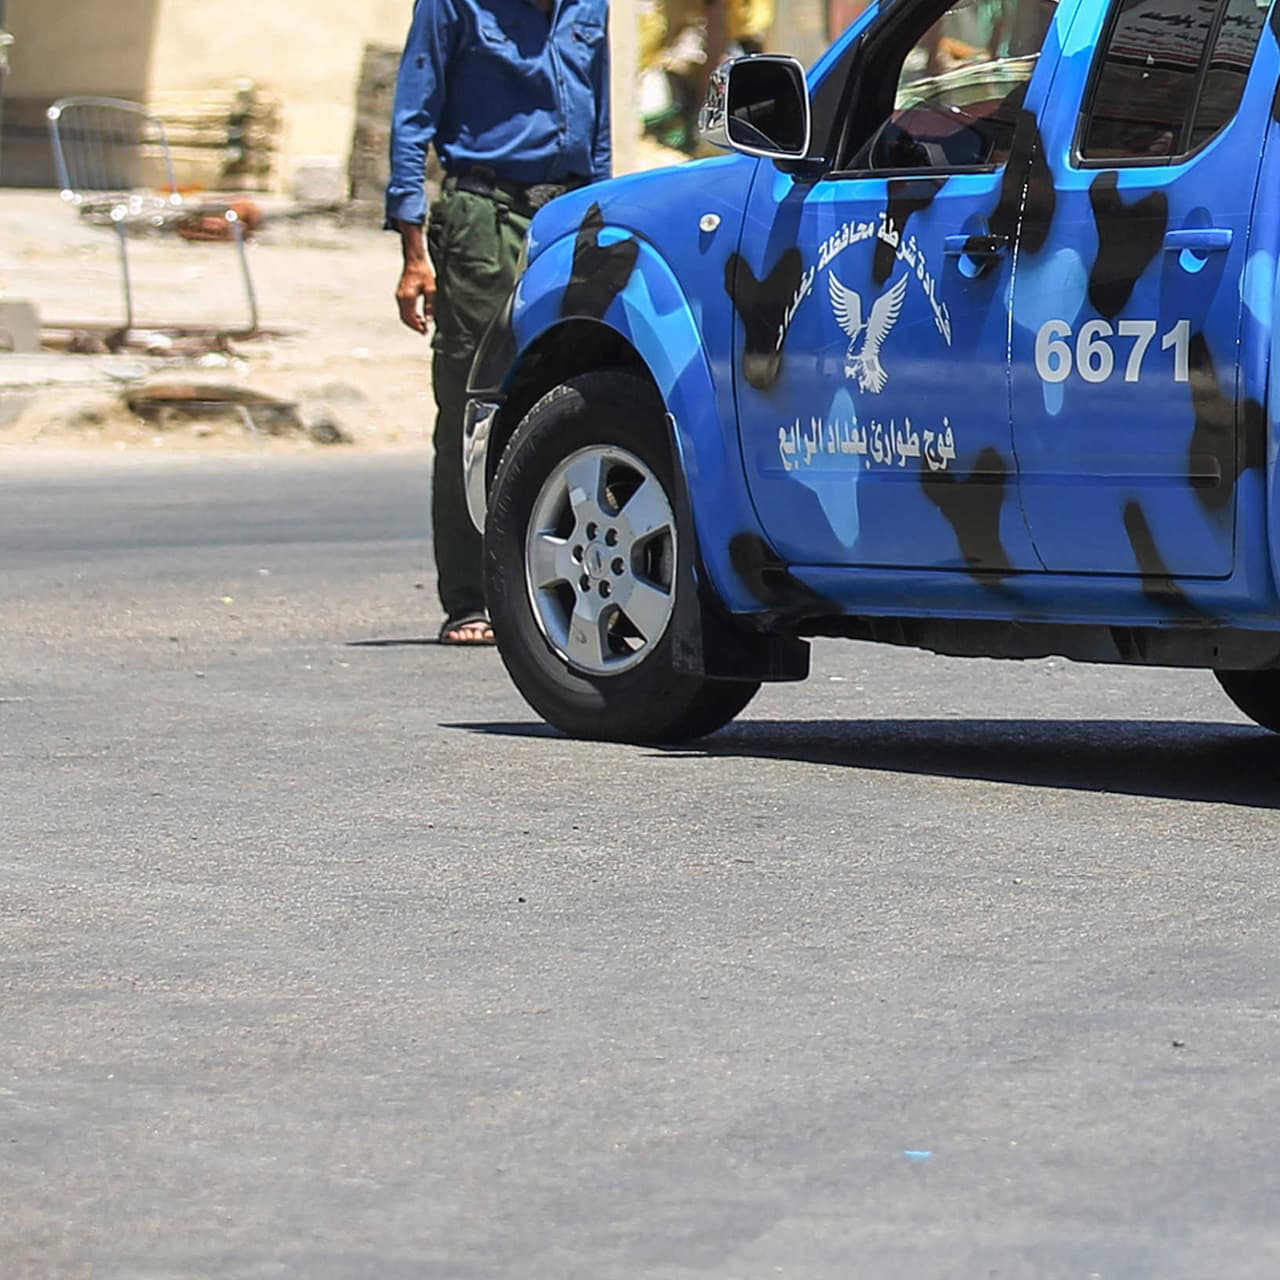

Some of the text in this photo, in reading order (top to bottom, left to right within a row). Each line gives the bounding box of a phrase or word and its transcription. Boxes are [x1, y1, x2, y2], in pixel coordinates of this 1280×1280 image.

[818, 221, 874, 270] محافظة
[877, 212, 916, 267] شرطة
[776, 266, 815, 350] بغداد
[1035, 319, 1190, 382] 6671
[778, 416, 957, 471] فوج طوارئ بغداد الرابع
